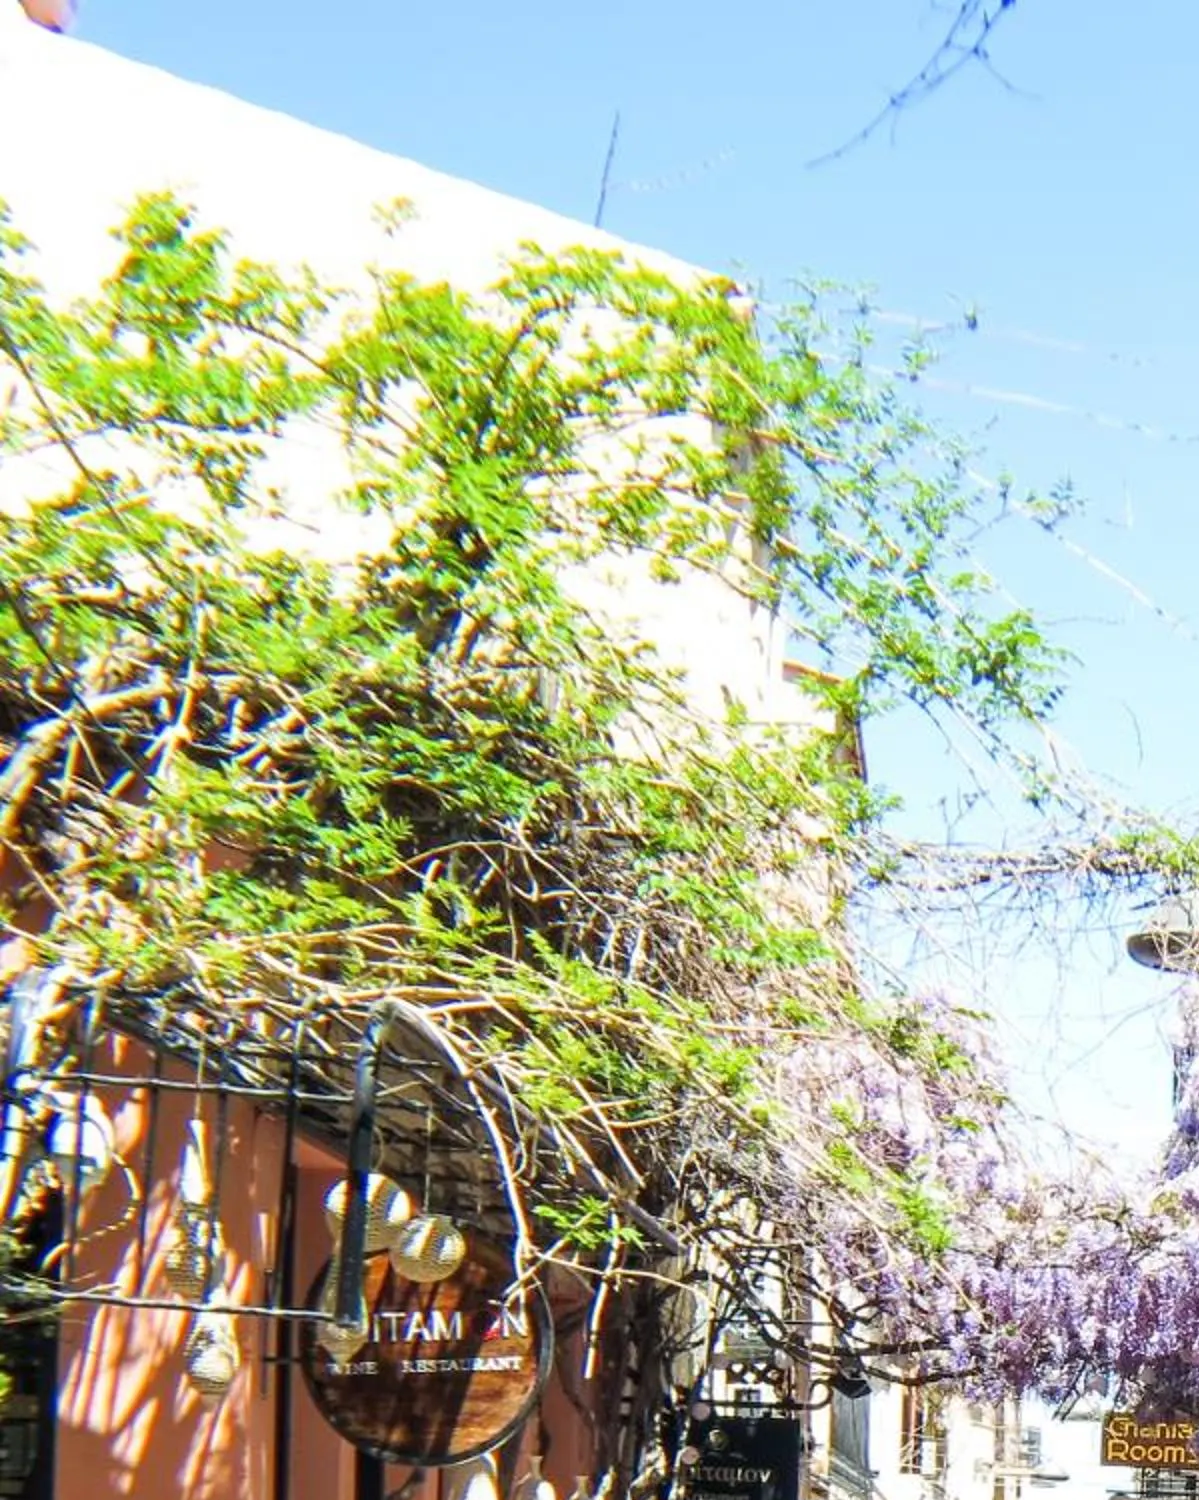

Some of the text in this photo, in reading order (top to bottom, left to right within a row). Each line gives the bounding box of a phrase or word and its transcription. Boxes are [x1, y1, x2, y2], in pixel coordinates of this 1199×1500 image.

[372, 1309, 528, 1342] ITAMN
[326, 1356, 523, 1375] WINE RESTAURANT
